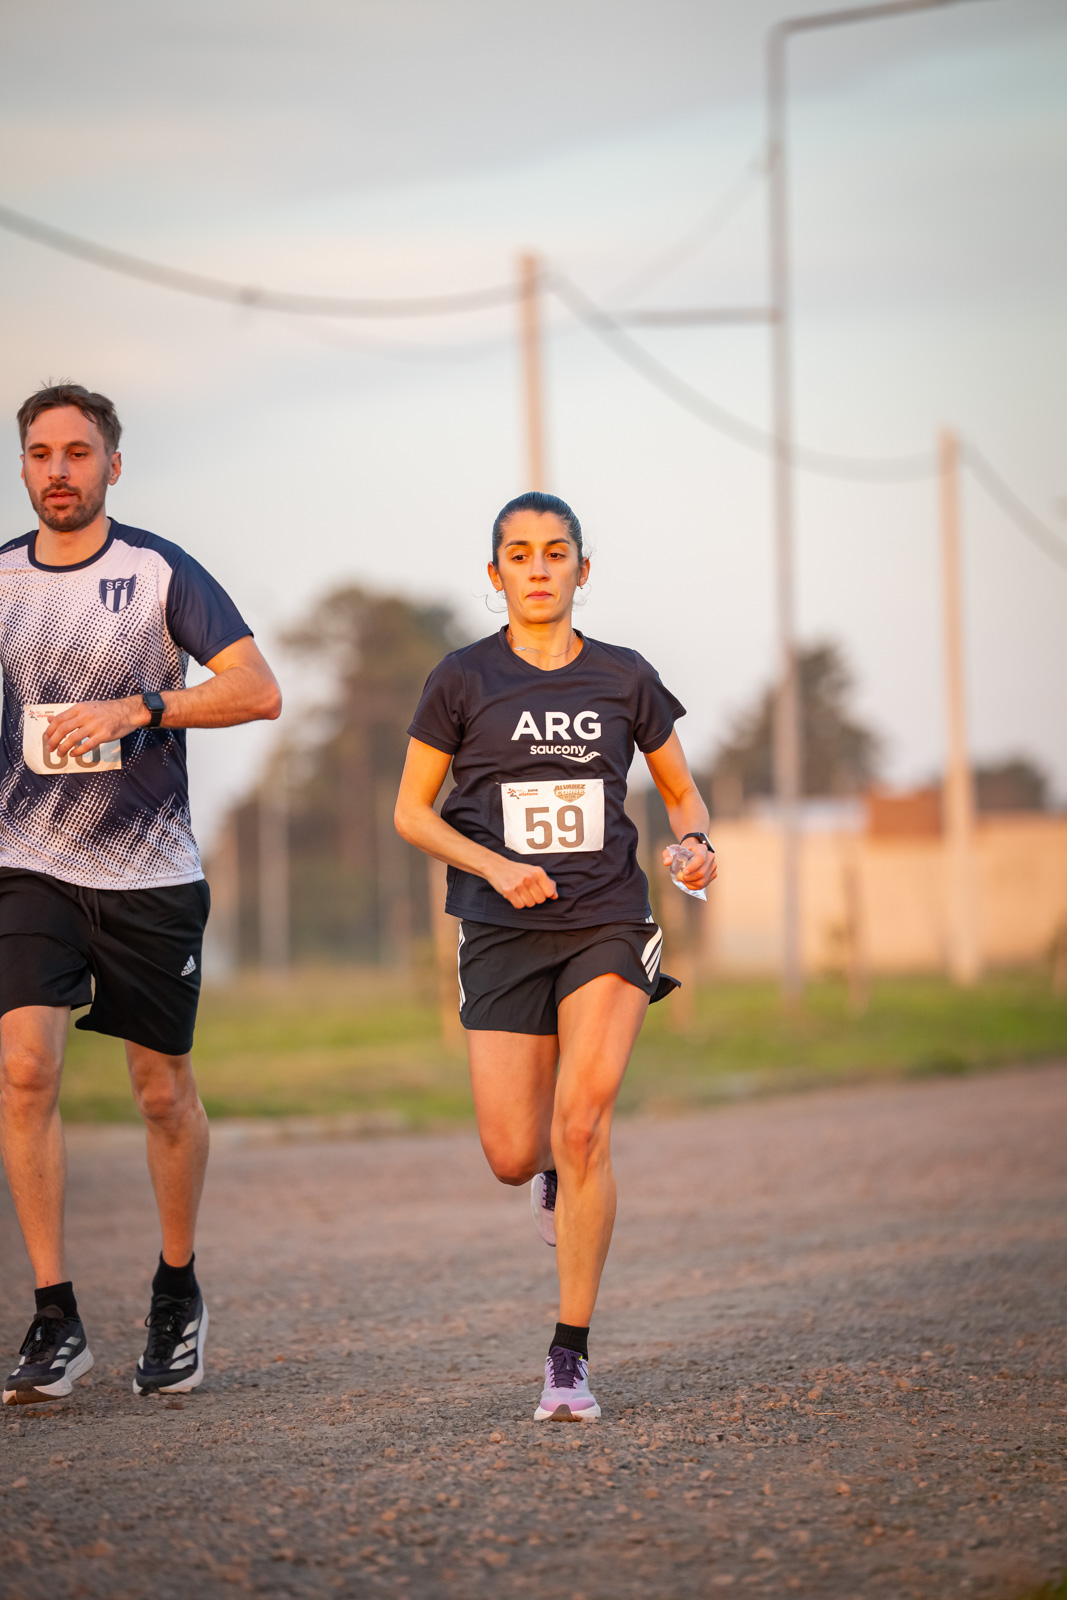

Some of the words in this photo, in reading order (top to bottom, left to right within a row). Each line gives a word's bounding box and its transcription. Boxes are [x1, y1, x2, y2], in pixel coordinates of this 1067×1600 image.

[105, 580, 131, 590] SFC
[510, 710, 602, 741] ARG
[529, 744, 587, 757] saucony
[524, 804, 585, 850] 59
